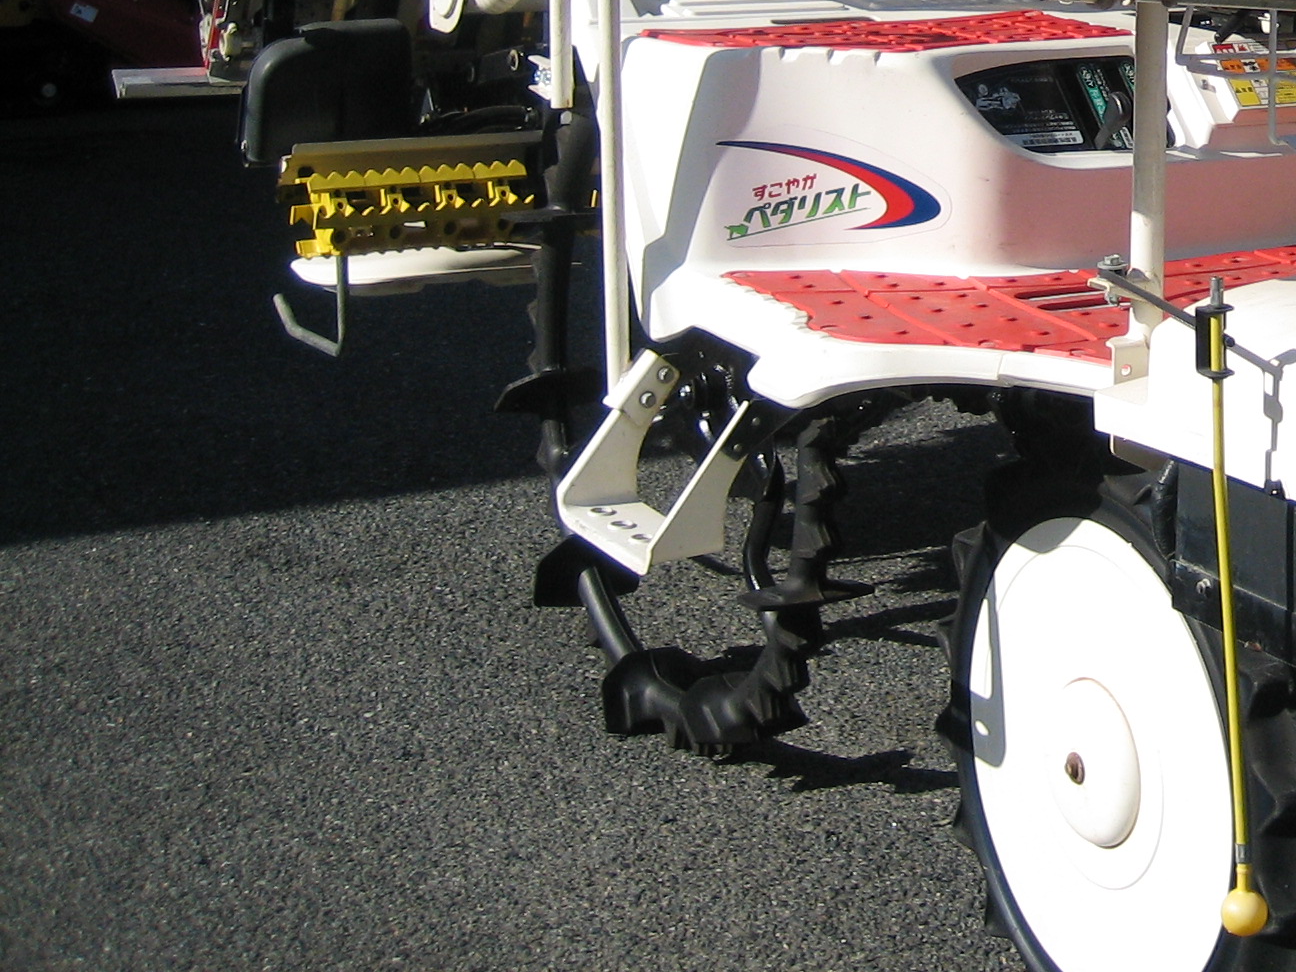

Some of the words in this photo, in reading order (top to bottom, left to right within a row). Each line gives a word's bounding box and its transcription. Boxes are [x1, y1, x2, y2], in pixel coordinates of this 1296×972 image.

[743, 183, 871, 228] ペダリスト
